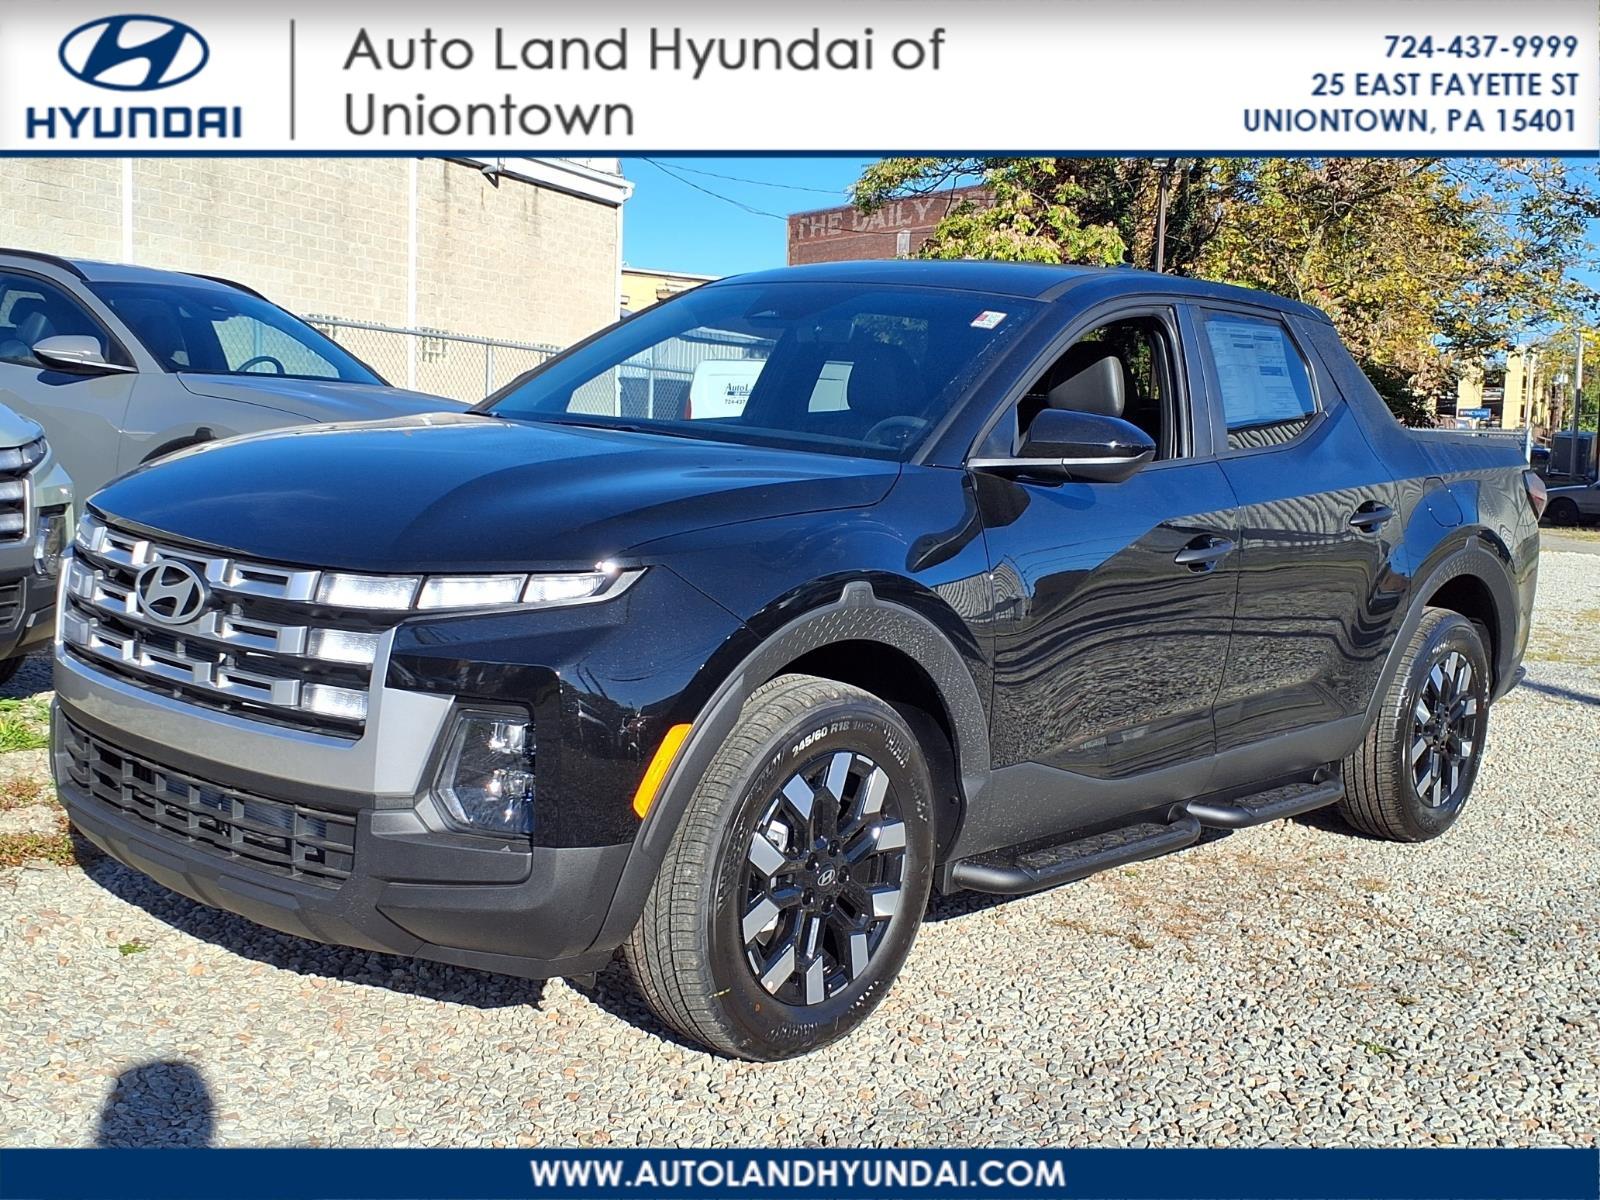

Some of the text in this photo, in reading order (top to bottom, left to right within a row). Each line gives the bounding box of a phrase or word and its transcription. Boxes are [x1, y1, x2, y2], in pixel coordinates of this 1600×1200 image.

[797, 210, 843, 240] THE
[852, 198, 936, 232] DAILY
[792, 726, 829, 758] 245/60
